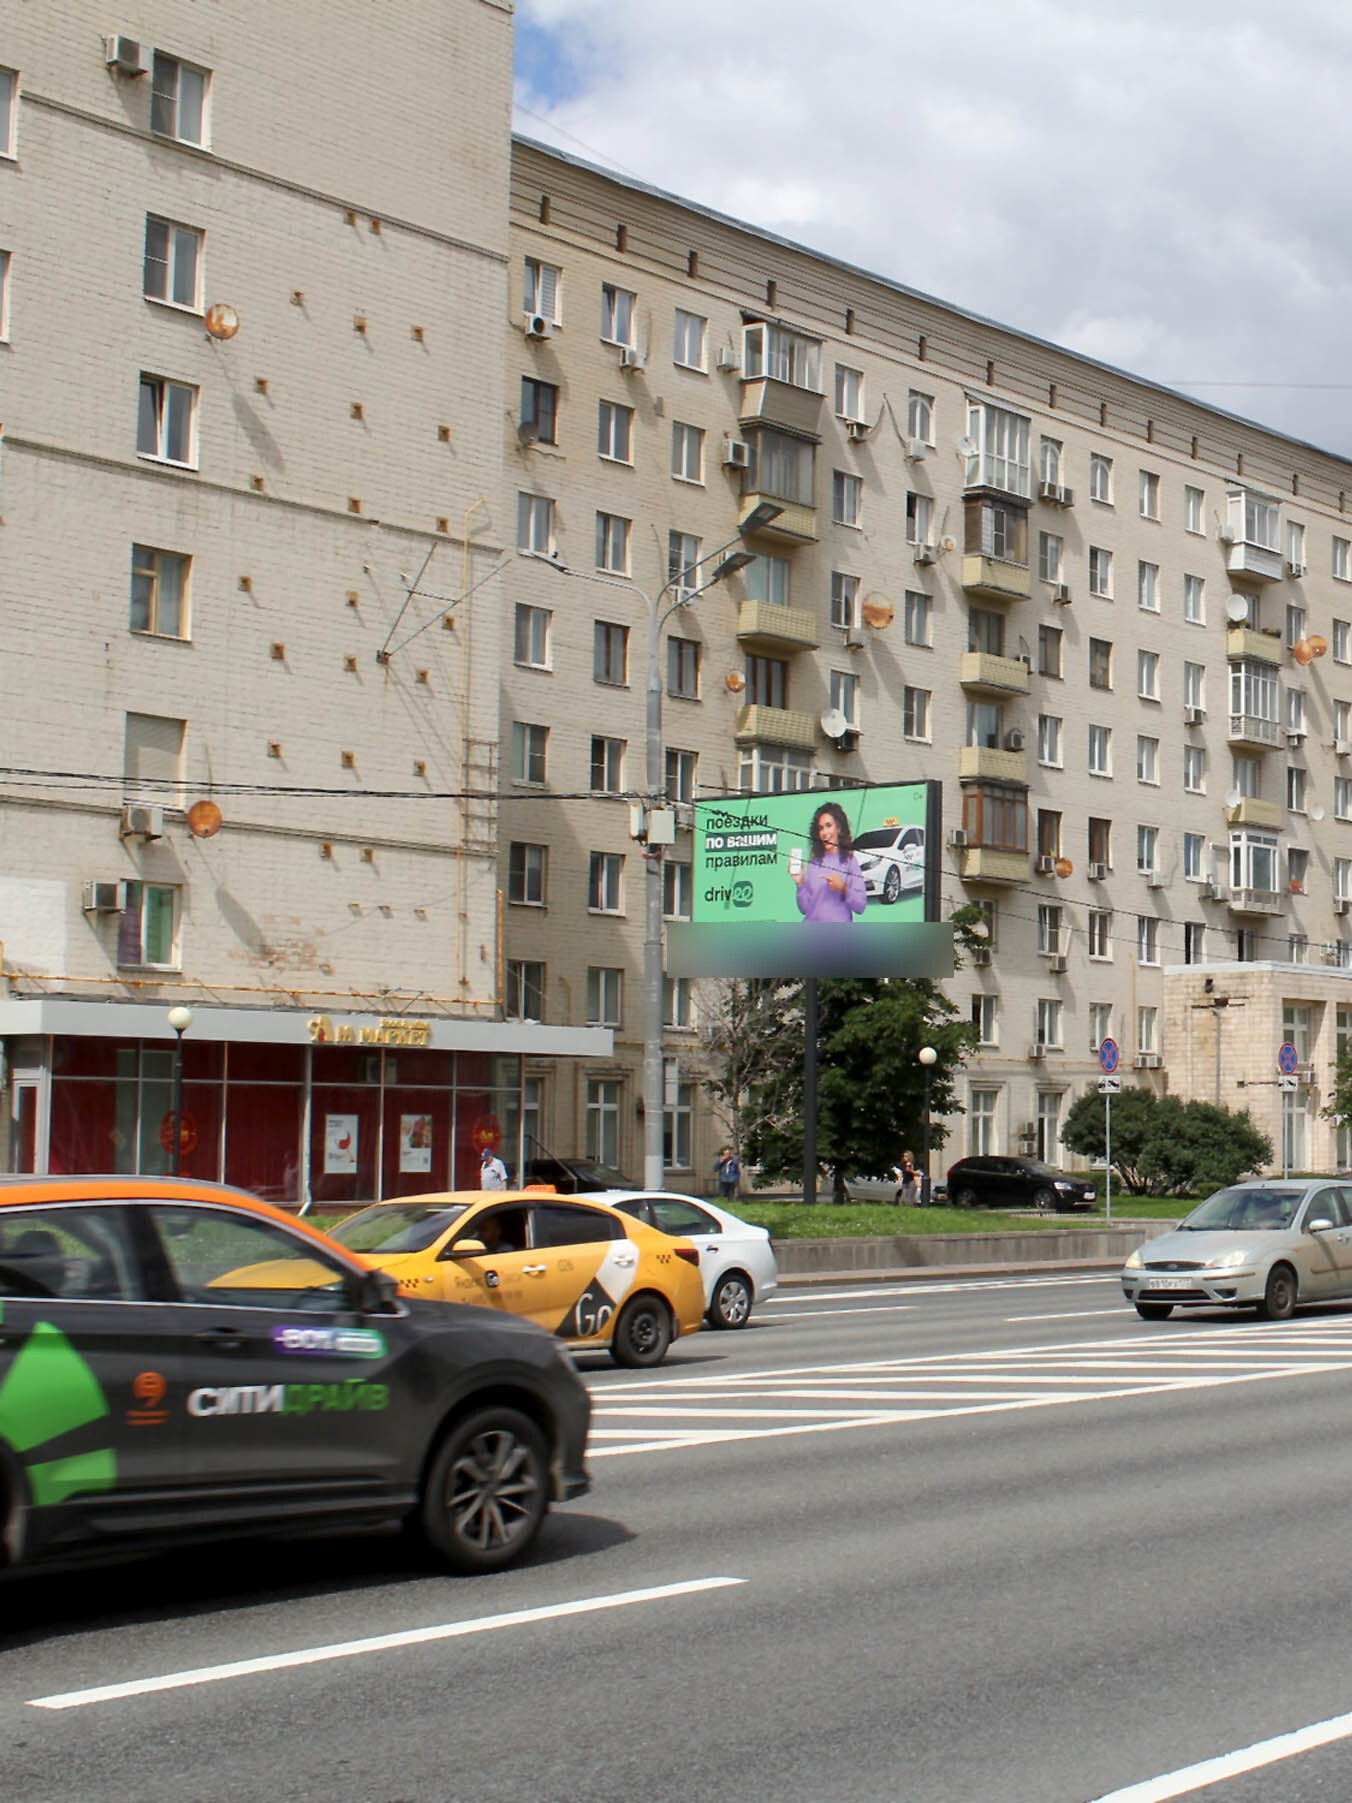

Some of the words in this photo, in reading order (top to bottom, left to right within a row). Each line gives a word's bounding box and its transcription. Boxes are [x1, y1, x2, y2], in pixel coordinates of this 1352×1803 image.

[706, 814, 768, 830] поездки
[706, 837, 724, 850] по
[726, 833, 777, 848] вашим
[706, 853, 777, 872] правилам
[575, 1293, 614, 1336] Go
[187, 1377, 390, 1417] СИТИДРАЙВ
